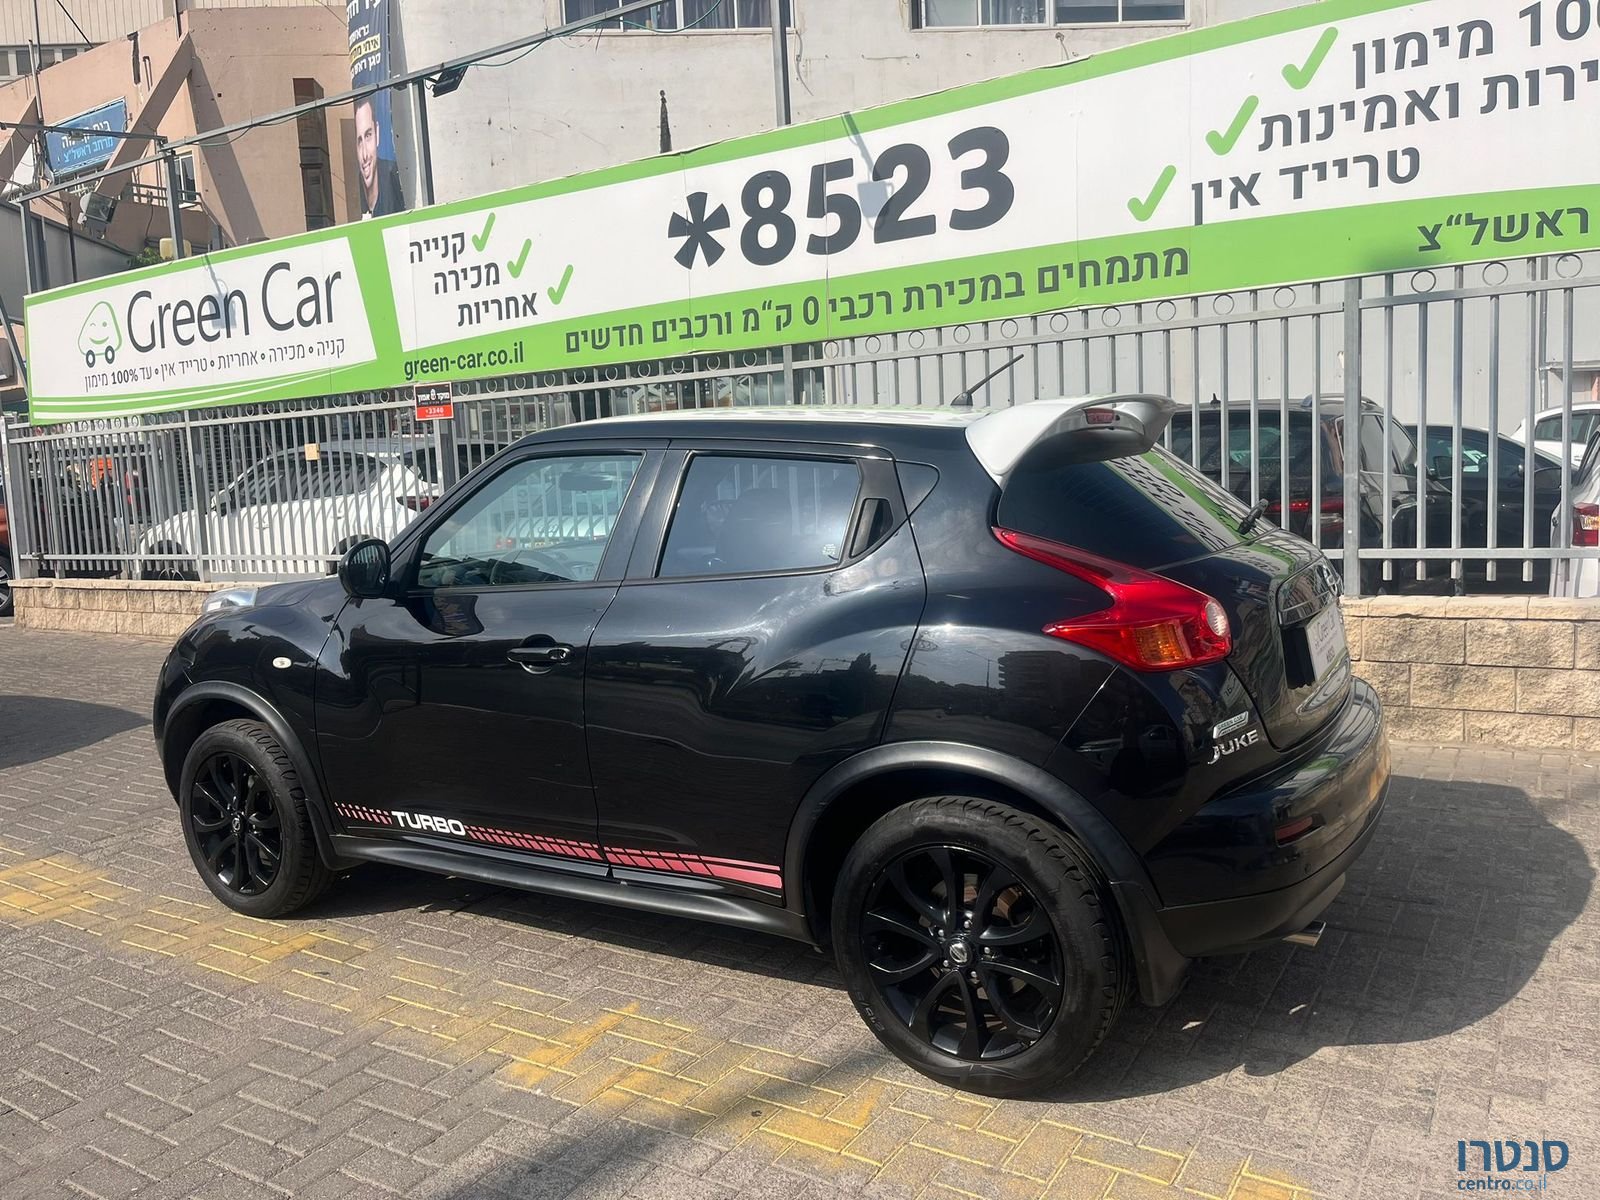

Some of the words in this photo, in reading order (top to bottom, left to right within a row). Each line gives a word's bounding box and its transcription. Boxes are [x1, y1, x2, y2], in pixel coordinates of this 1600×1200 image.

[1519, 0, 1600, 47] 10
[1352, 19, 1493, 89] מימון
[1258, 82, 1459, 152] ואמינות
[1279, 147, 1420, 200] טרייד
[1192, 172, 1261, 225] אין
[1417, 207, 1589, 252] ראשל"צ
[409, 232, 466, 263] קנייה
[434, 262, 500, 294] מכירה
[1038, 247, 1188, 293] מתמחים
[126, 289, 250, 353] Green
[261, 262, 342, 331] Car
[828, 290, 892, 321] רכבי
[902, 271, 1025, 312] במכירת
[457, 292, 538, 327] אחריות
[742, 300, 792, 332] ק"מ
[803, 295, 819, 325] 0
[565, 323, 643, 353] חדשים
[652, 311, 732, 343] ורכבים
[218, 350, 258, 369] אחריות
[269, 344, 305, 362] מכירה
[317, 338, 345, 359] קניה
[404, 341, 524, 381] green-car.co.il
[111, 368, 138, 385] 100%
[139, 366, 152, 380] עד
[161, 362, 176, 382] אין
[178, 358, 207, 374] טרייד
[84, 373, 108, 392] מימון
[1207, 729, 1259, 764] JUKE
[391, 811, 466, 836] TURBO
